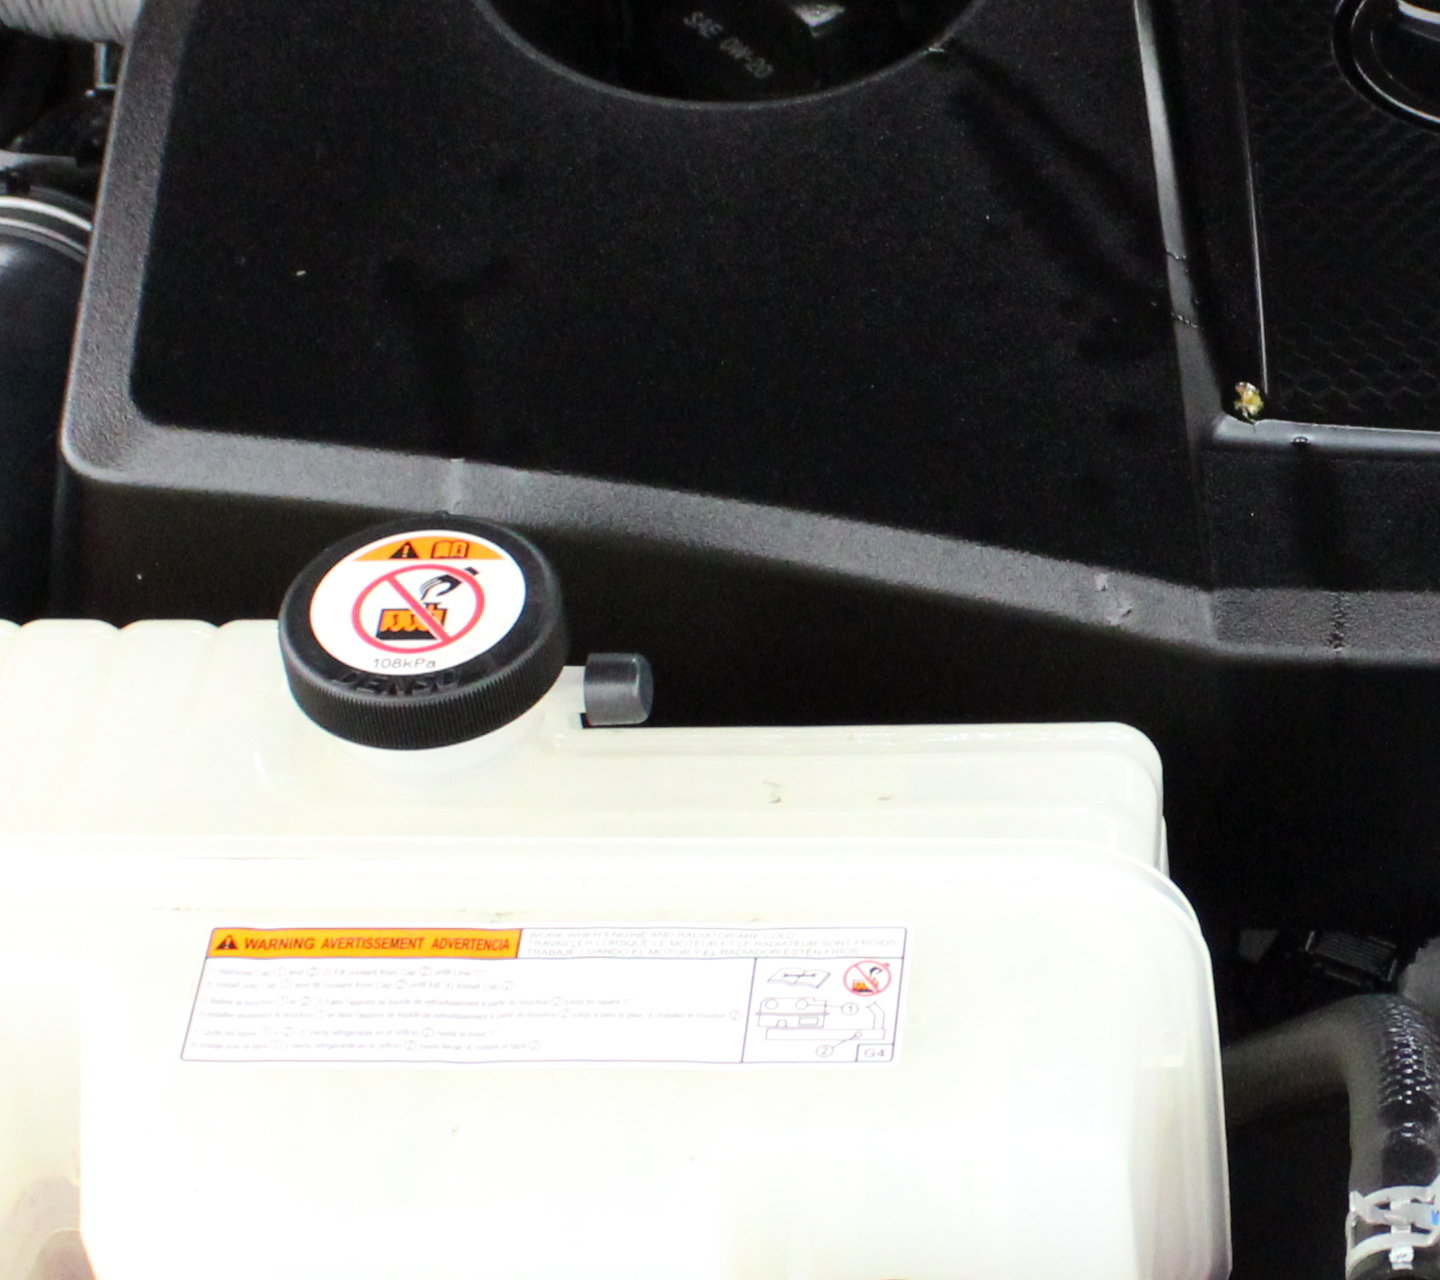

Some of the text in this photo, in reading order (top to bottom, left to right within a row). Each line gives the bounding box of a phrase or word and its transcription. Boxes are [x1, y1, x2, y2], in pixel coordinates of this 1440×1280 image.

[372, 657, 437, 669] 108kPa
[244, 937, 510, 951] WARNING AVERTISSEMENT ADVERTENCIA
[864, 1048, 885, 1058] G4
